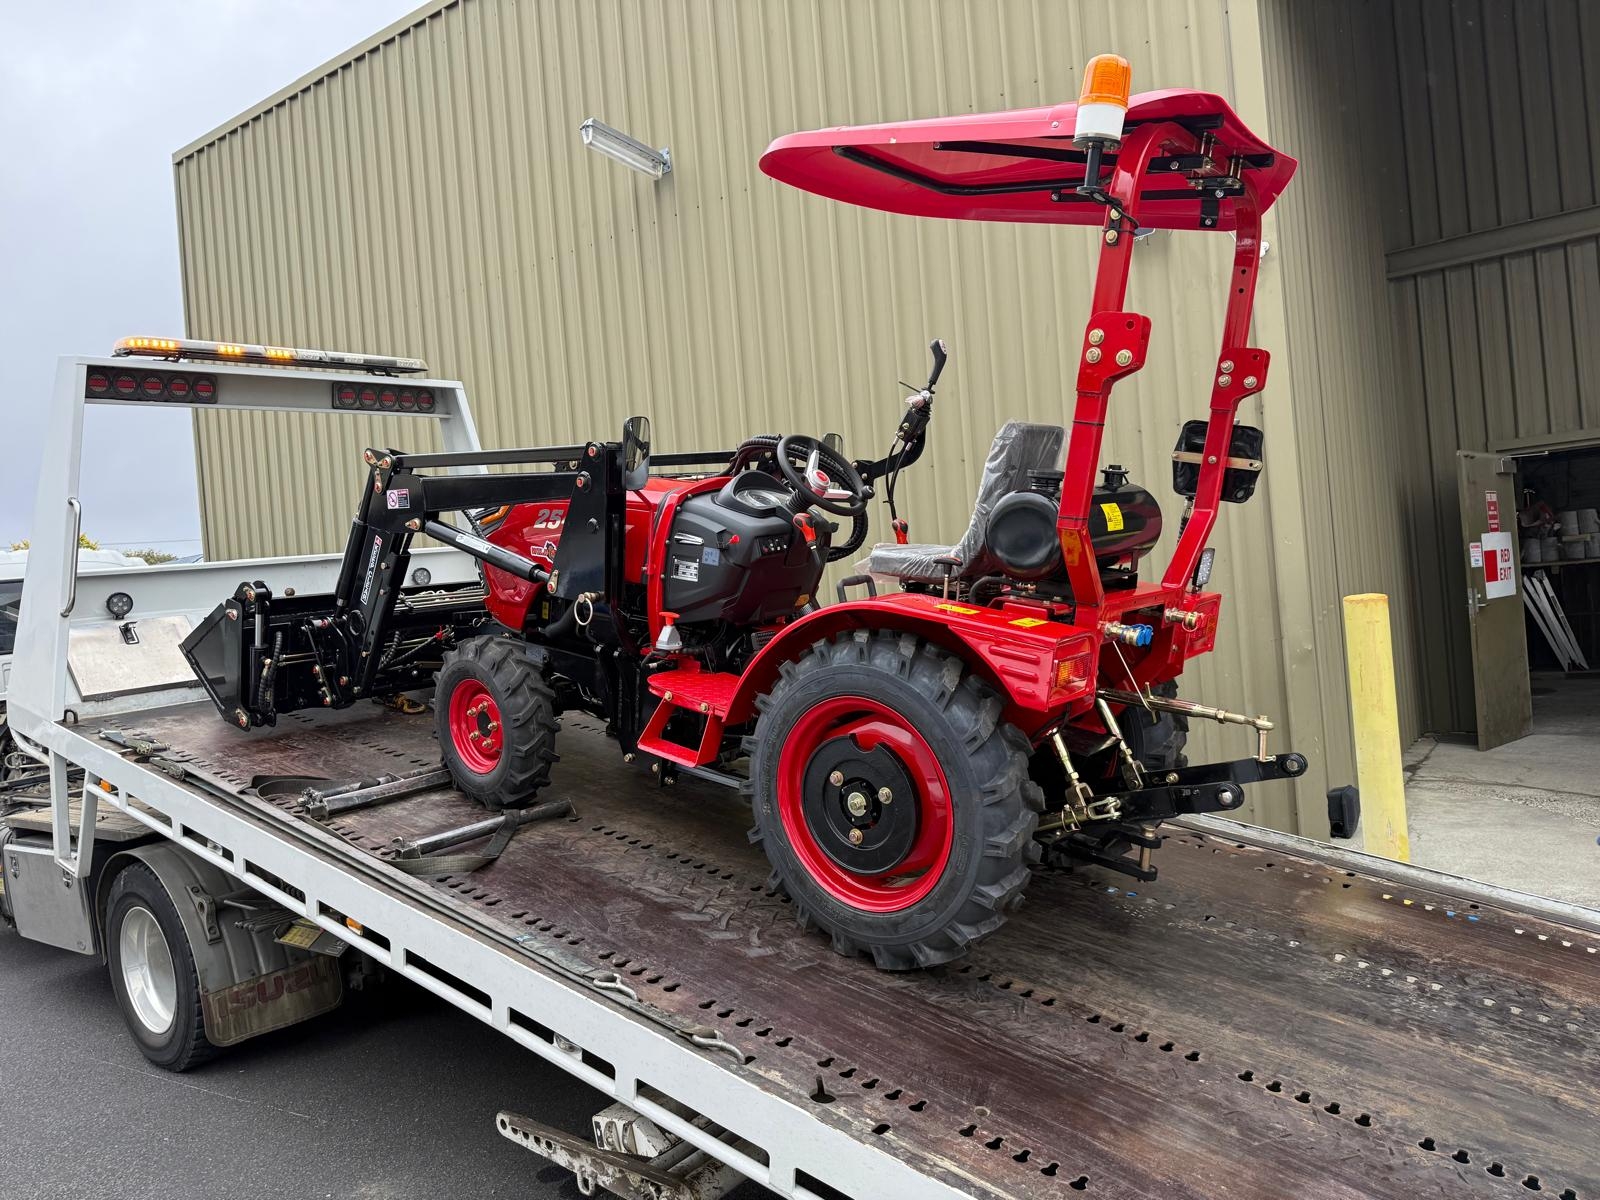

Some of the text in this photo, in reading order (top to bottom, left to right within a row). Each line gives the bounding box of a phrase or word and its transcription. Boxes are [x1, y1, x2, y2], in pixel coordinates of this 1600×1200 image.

[533, 508, 565, 529] 25
[1500, 548, 1511, 563] RED
[1500, 566, 1512, 581] EXIT
